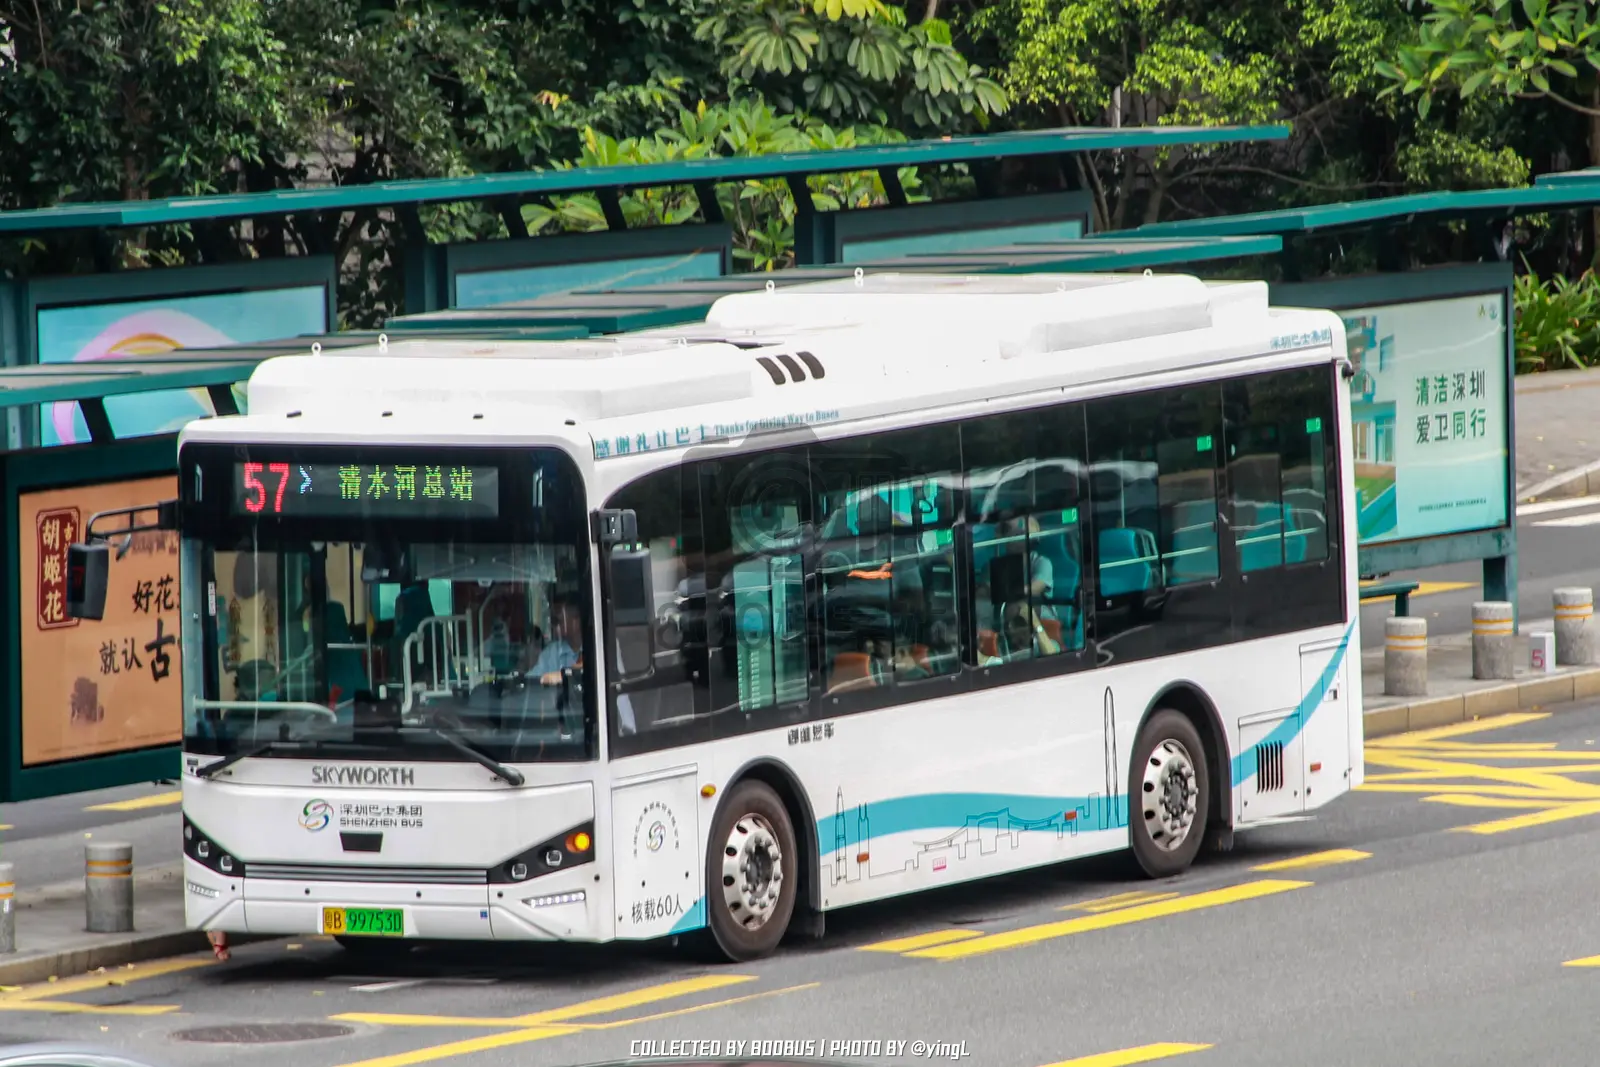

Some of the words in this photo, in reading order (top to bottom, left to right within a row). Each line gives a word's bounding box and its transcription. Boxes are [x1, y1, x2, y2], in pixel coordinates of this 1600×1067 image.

[1415, 369, 1486, 407] 清洁深圳
[714, 419, 744, 436] Thanks
[746, 418, 758, 431] for
[787, 412, 804, 426] Way
[806, 411, 815, 423] to
[1415, 408, 1486, 445] 爱卫同行
[243, 462, 290, 513] 57
[338, 464, 474, 501] 清水河总站
[42, 518, 64, 623] 胡姬花
[132, 574, 181, 615] 好花
[99, 618, 182, 682] 就认古
[1530, 648, 1545, 669] 5
[311, 765, 415, 786] SKYWORTH
[340, 803, 423, 817] 深圳巴士集团
[340, 818, 398, 828] SHENZHEN
[401, 818, 423, 828] BUS
[632, 893, 684, 924] 核载60人
